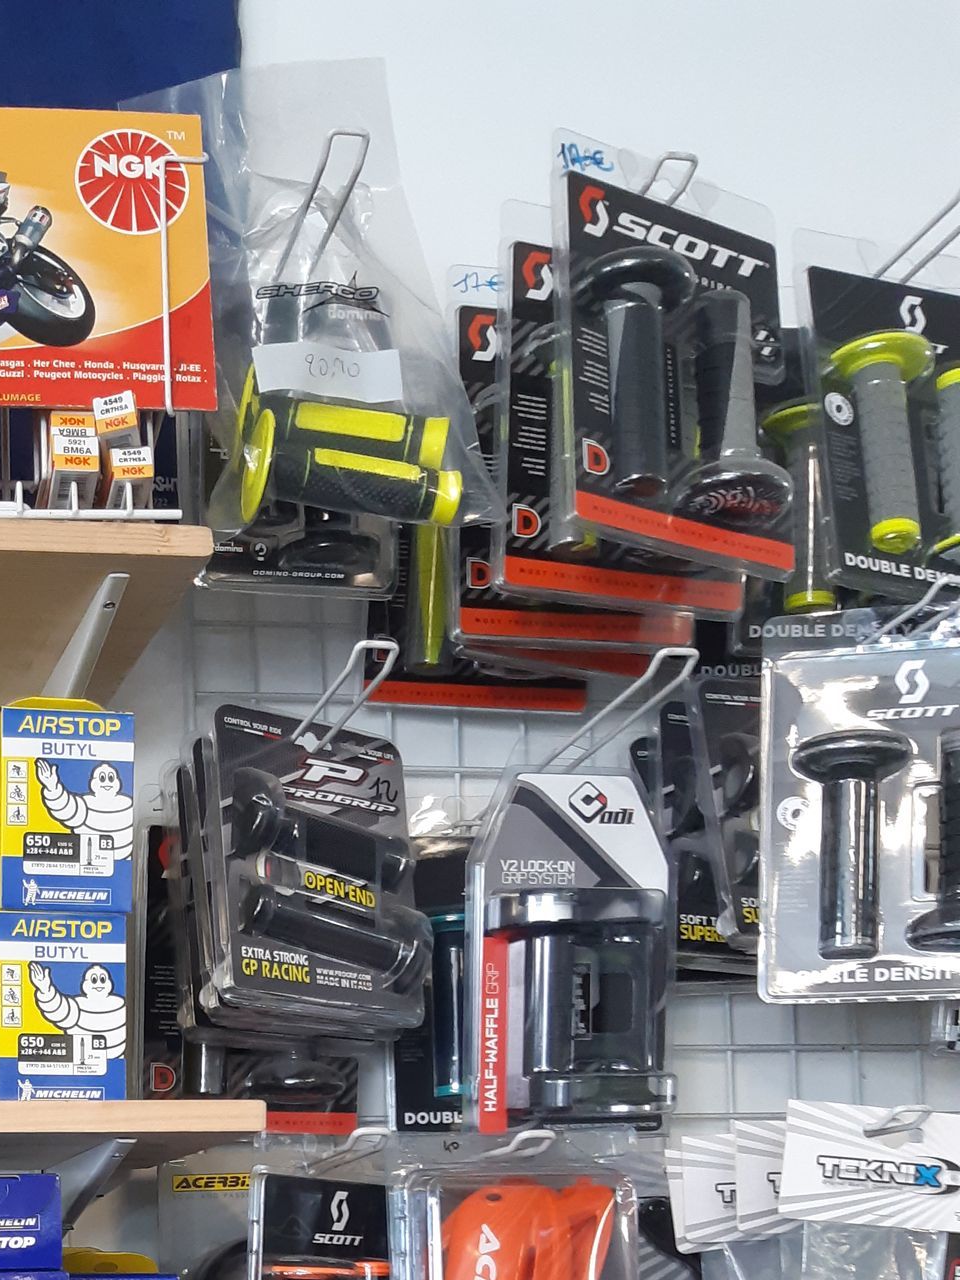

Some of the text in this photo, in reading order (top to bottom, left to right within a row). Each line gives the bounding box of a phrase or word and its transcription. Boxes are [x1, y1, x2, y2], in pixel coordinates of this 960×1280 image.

[95, 155, 165, 178] NGK
[613, 212, 767, 278] SCOTT
[255, 281, 380, 301] SHERCO
[33, 359, 50, 368] Her
[52, 359, 76, 368] Chee
[84, 360, 114, 369] Honda
[33, 370, 124, 381] Peugeot Motocycles
[63, 445, 92, 455] BM6A
[65, 456, 91, 466] NGK
[252, 569, 345, 580] DOMINO-GROUP.COM
[844, 552, 911, 578] DOUBLE
[749, 624, 826, 638] DOUBLE
[866, 703, 959, 721] SCOTT
[18, 714, 121, 736] AIRSTOP
[41, 742, 97, 757] BUTYL
[281, 785, 399, 816] PROGRIP
[500, 859, 575, 873] V2 LOCK-ON
[527, 872, 575, 885] SYSTEM
[303, 870, 376, 908] OPEN END
[12, 920, 113, 939] AIRSTOP
[241, 946, 309, 966] EXTRA STRONG
[242, 958, 311, 984] GP RACING
[486, 962, 500, 995] GRIP
[484, 997, 499, 1112] HALF-WAFFLE
[818, 1156, 941, 1188] TEKNIX
[312, 1233, 363, 1246] SCOTT
